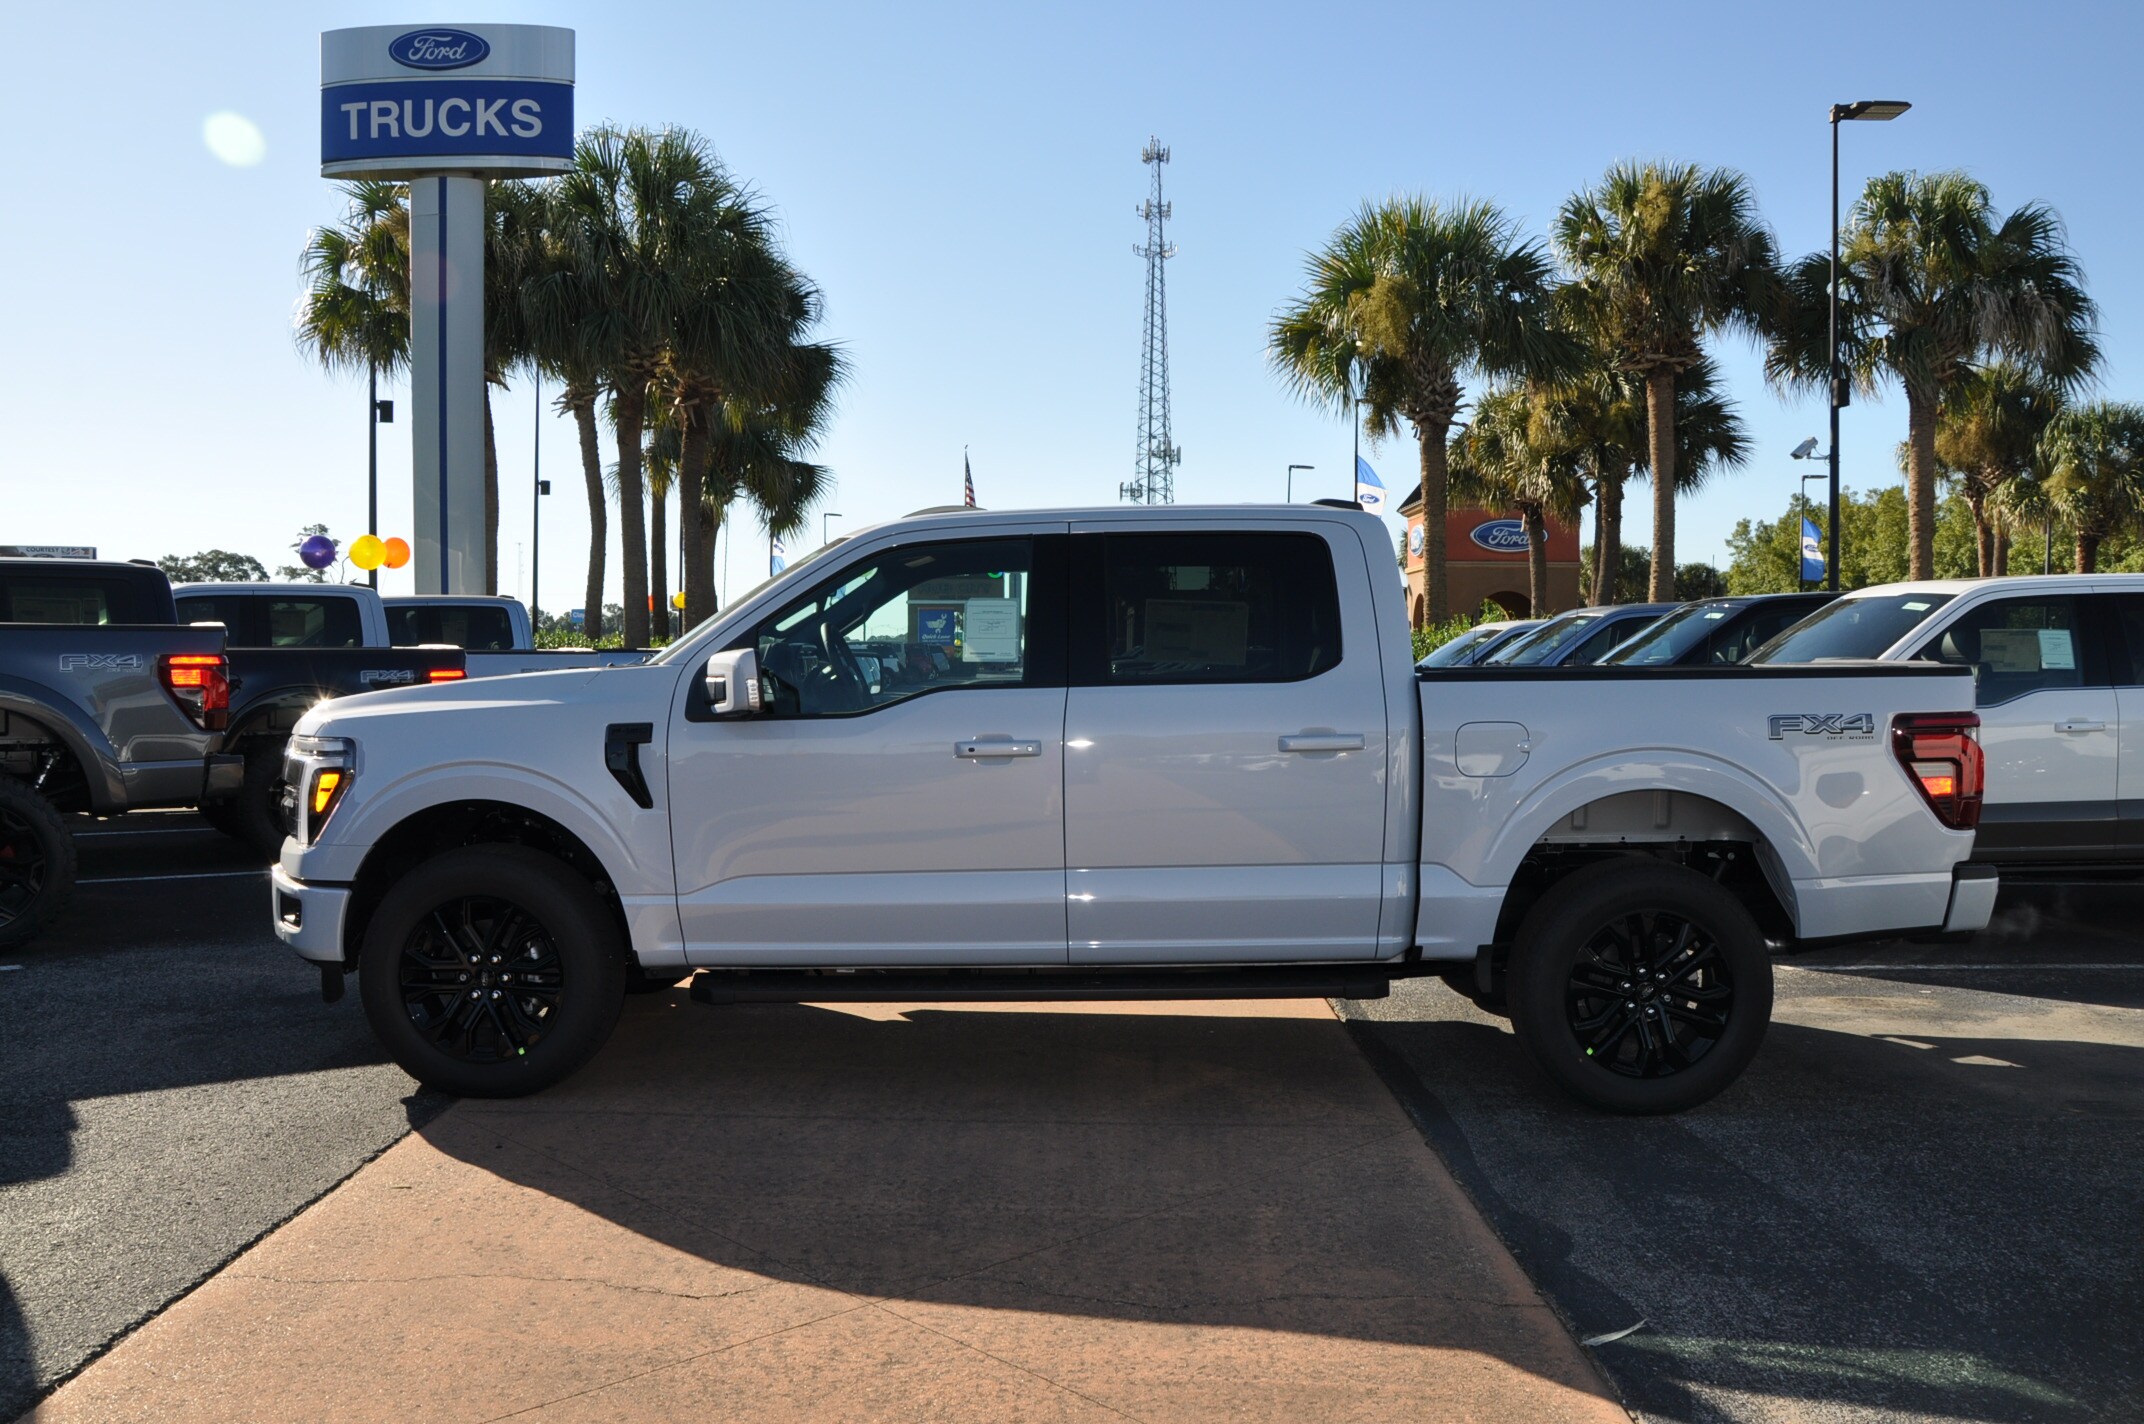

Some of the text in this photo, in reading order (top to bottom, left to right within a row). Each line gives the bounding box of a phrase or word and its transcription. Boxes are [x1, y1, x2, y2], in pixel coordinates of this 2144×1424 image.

[408, 36, 467, 61] Ford
[340, 97, 543, 140] TRUCKS
[60, 654, 143, 672] FX4
[360, 670, 414, 683] FX4
[1767, 713, 1875, 740] FX4
